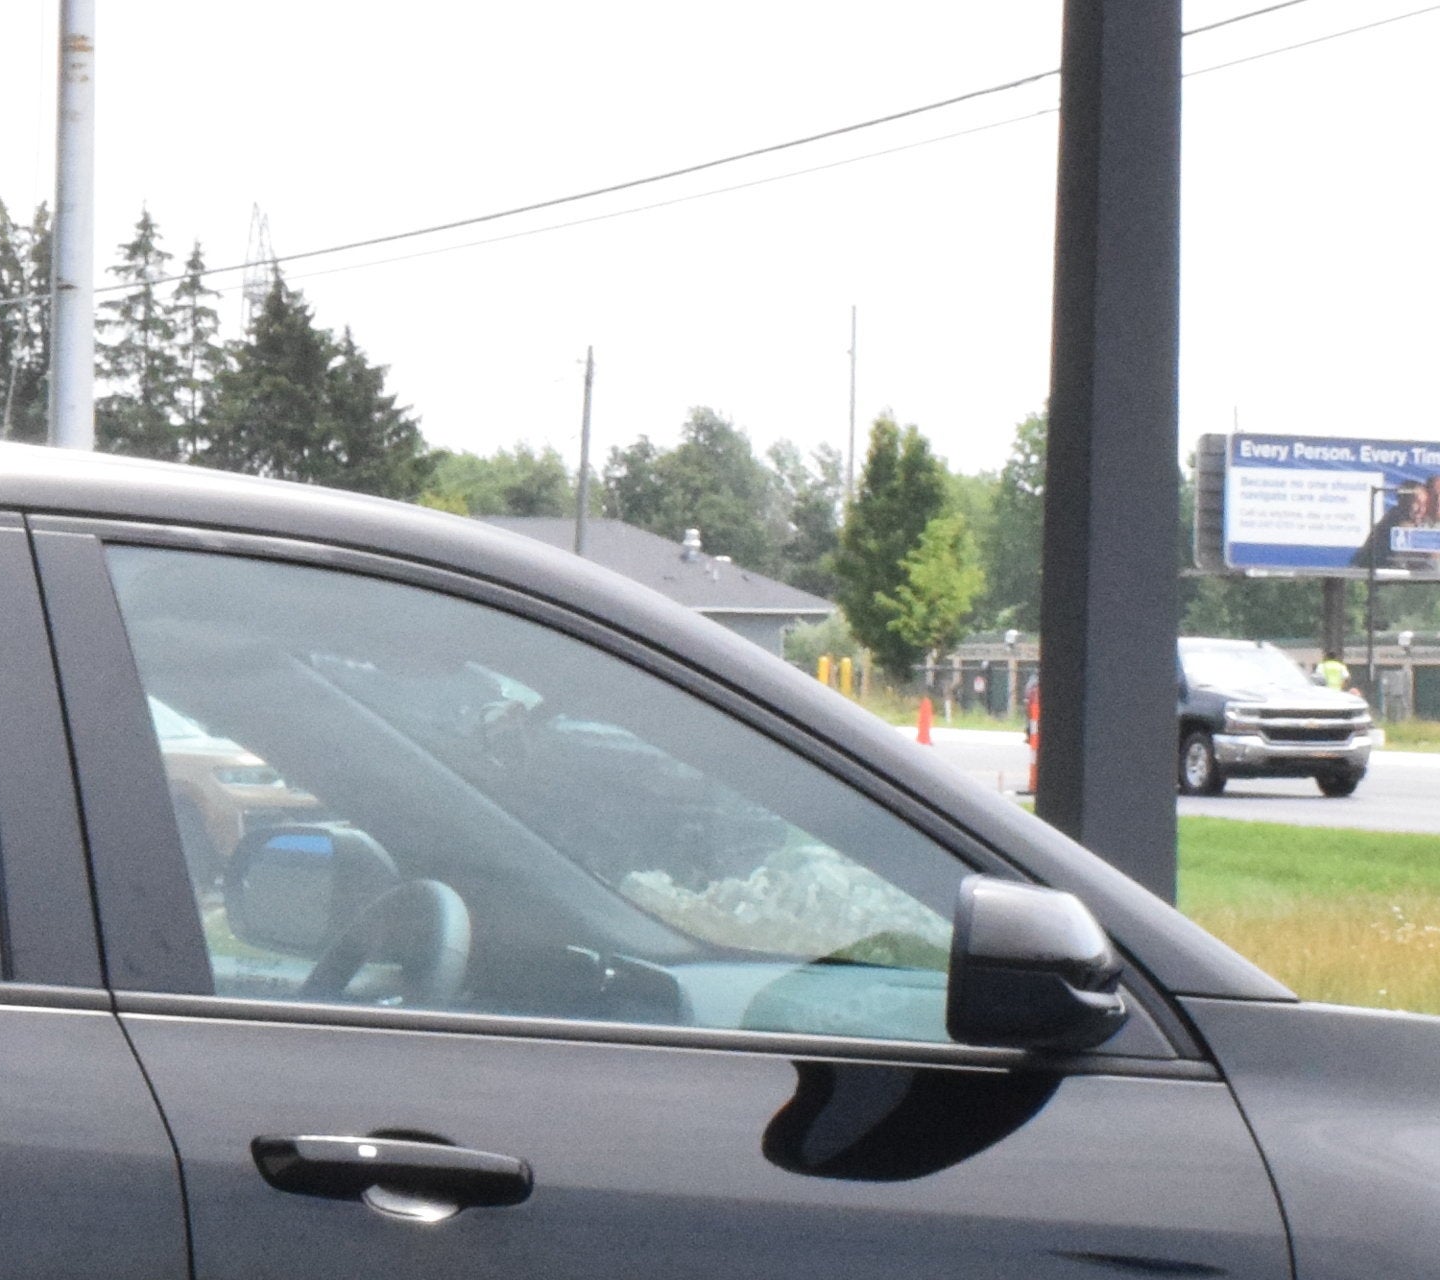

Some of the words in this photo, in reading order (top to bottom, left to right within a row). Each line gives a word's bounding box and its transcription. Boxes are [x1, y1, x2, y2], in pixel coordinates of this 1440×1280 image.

[1240, 440, 1289, 461] Every
[1293, 442, 1356, 461] Person.
[1360, 445, 1408, 466] Every
[1241, 477, 1286, 488] Because
